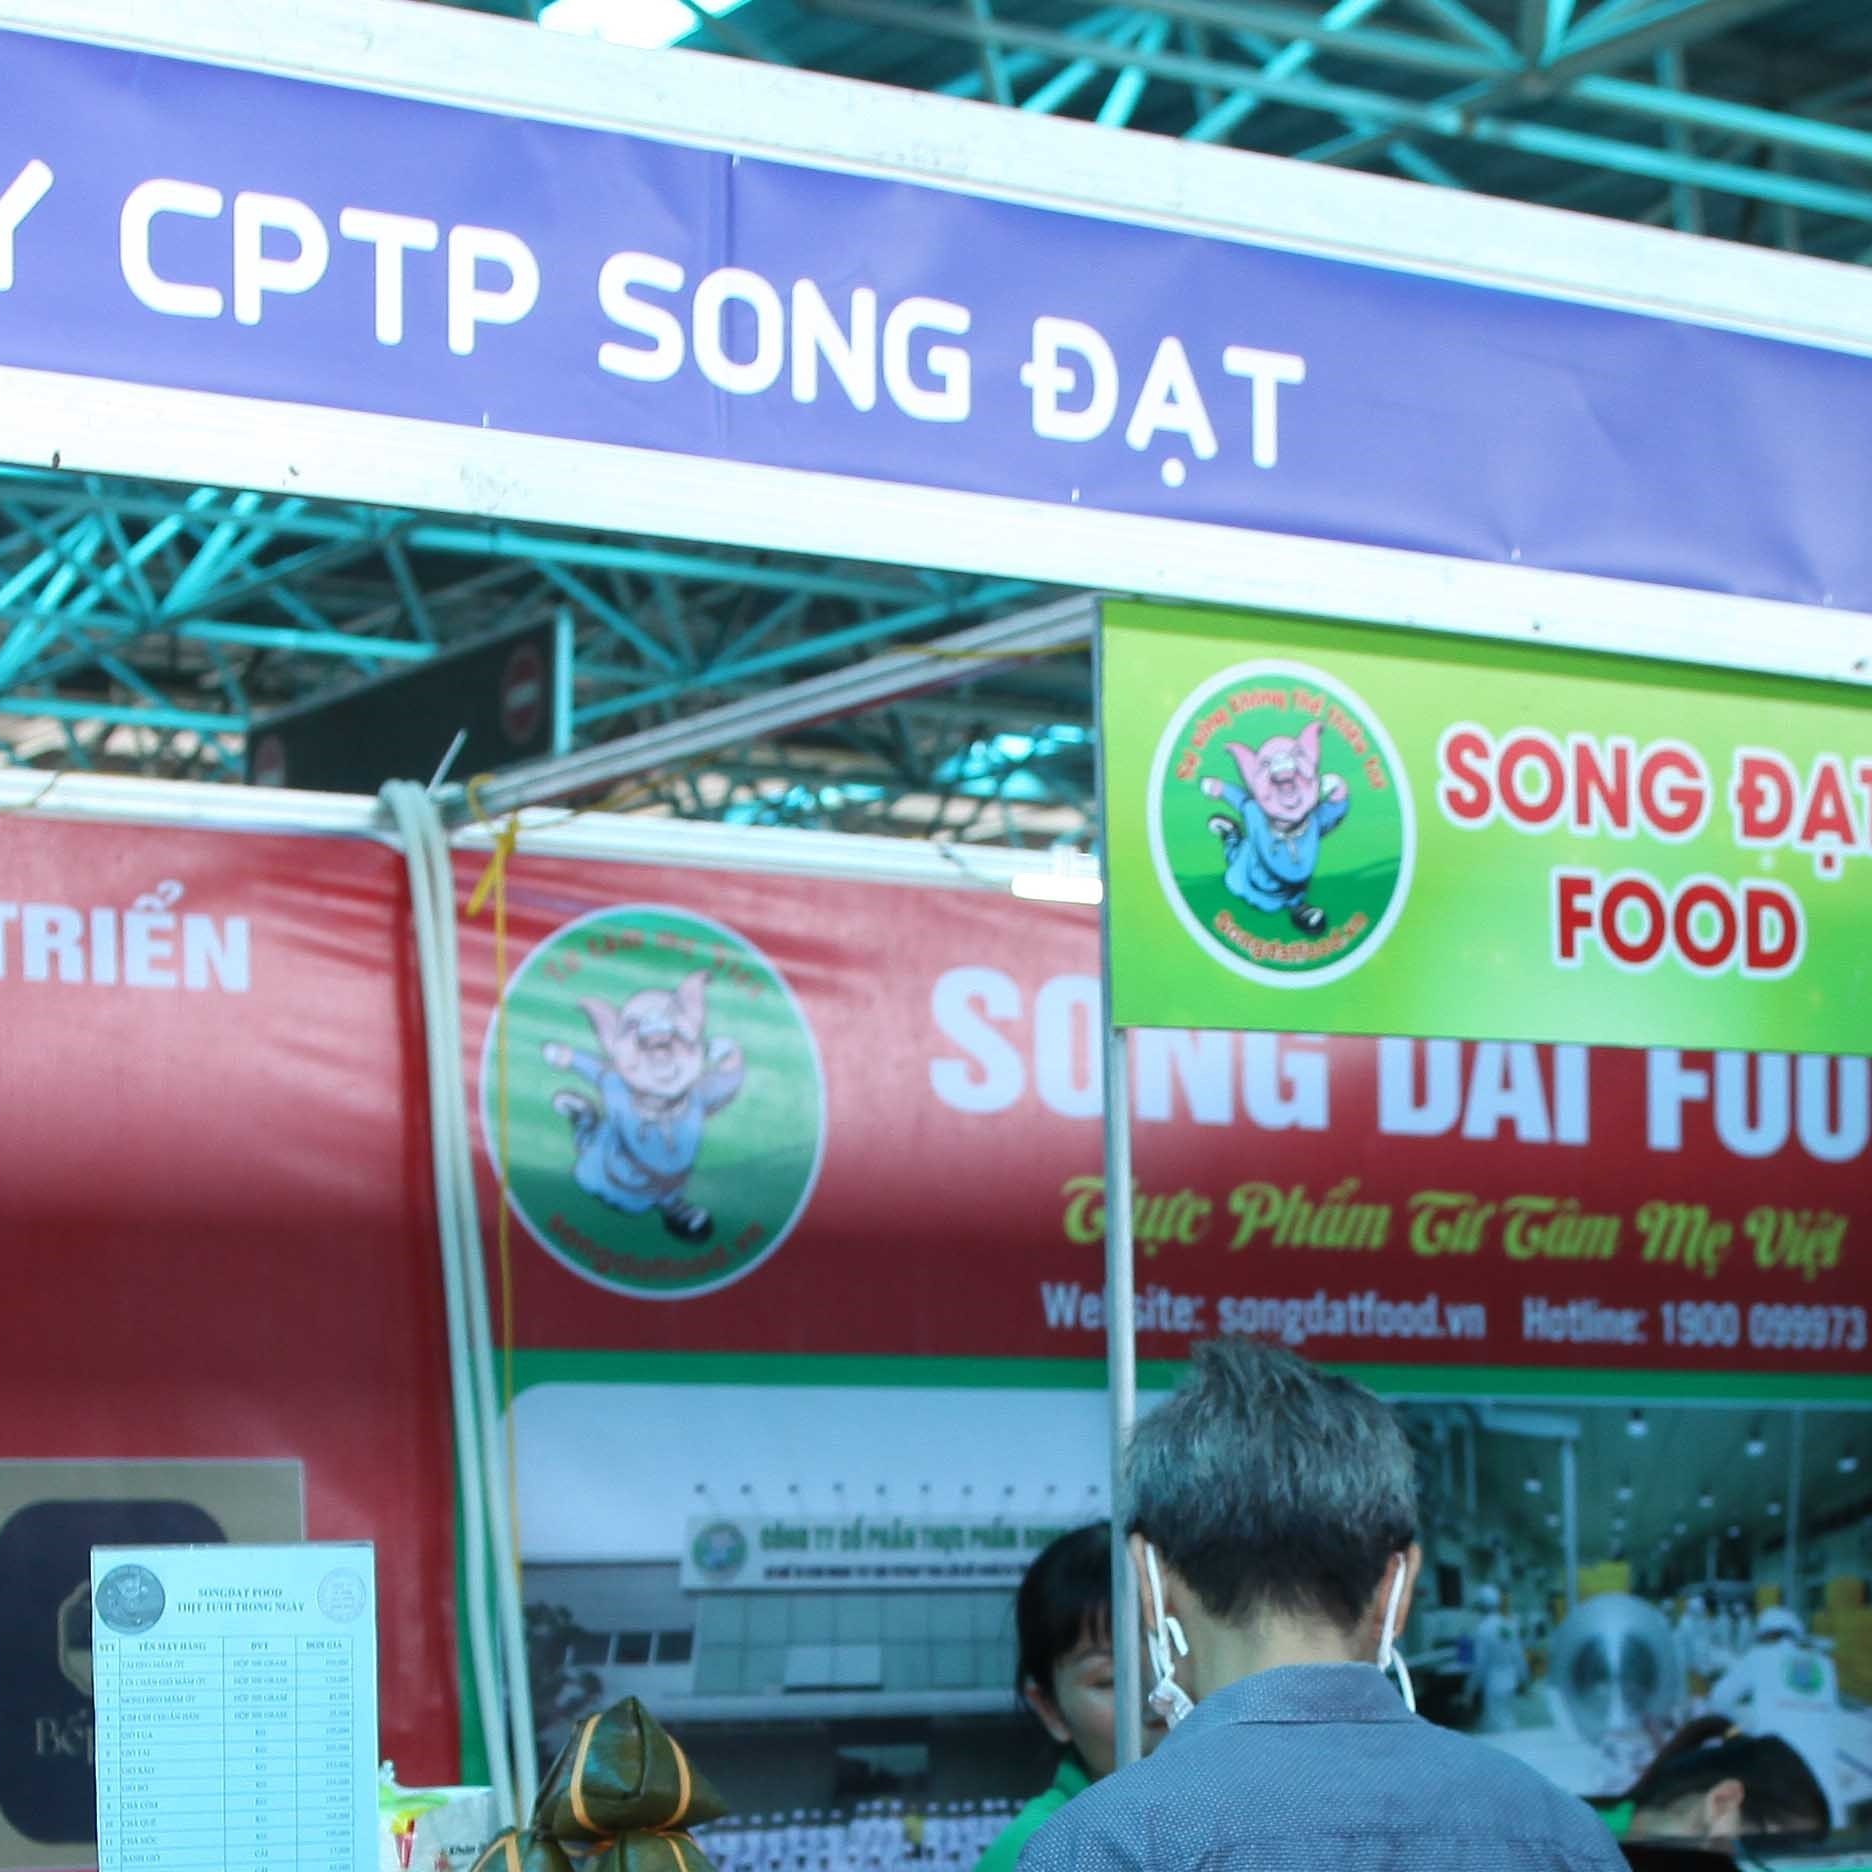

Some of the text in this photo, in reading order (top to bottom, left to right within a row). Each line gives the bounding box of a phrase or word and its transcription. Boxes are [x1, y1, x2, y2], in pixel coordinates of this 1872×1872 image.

[120, 178, 539, 355] CPTP
[597, 251, 971, 421] SONG
[1020, 316, 1306, 487] ĐẠT
[1442, 731, 1708, 836] SONG
[1555, 873, 1802, 972] FOOD
[1063, 1176, 1211, 1257] Tực
[1041, 1282, 1204, 1336] Wesite:
[1218, 1289, 1486, 1346] songdatfood.vn
[1662, 1303, 1740, 1349] 1900
